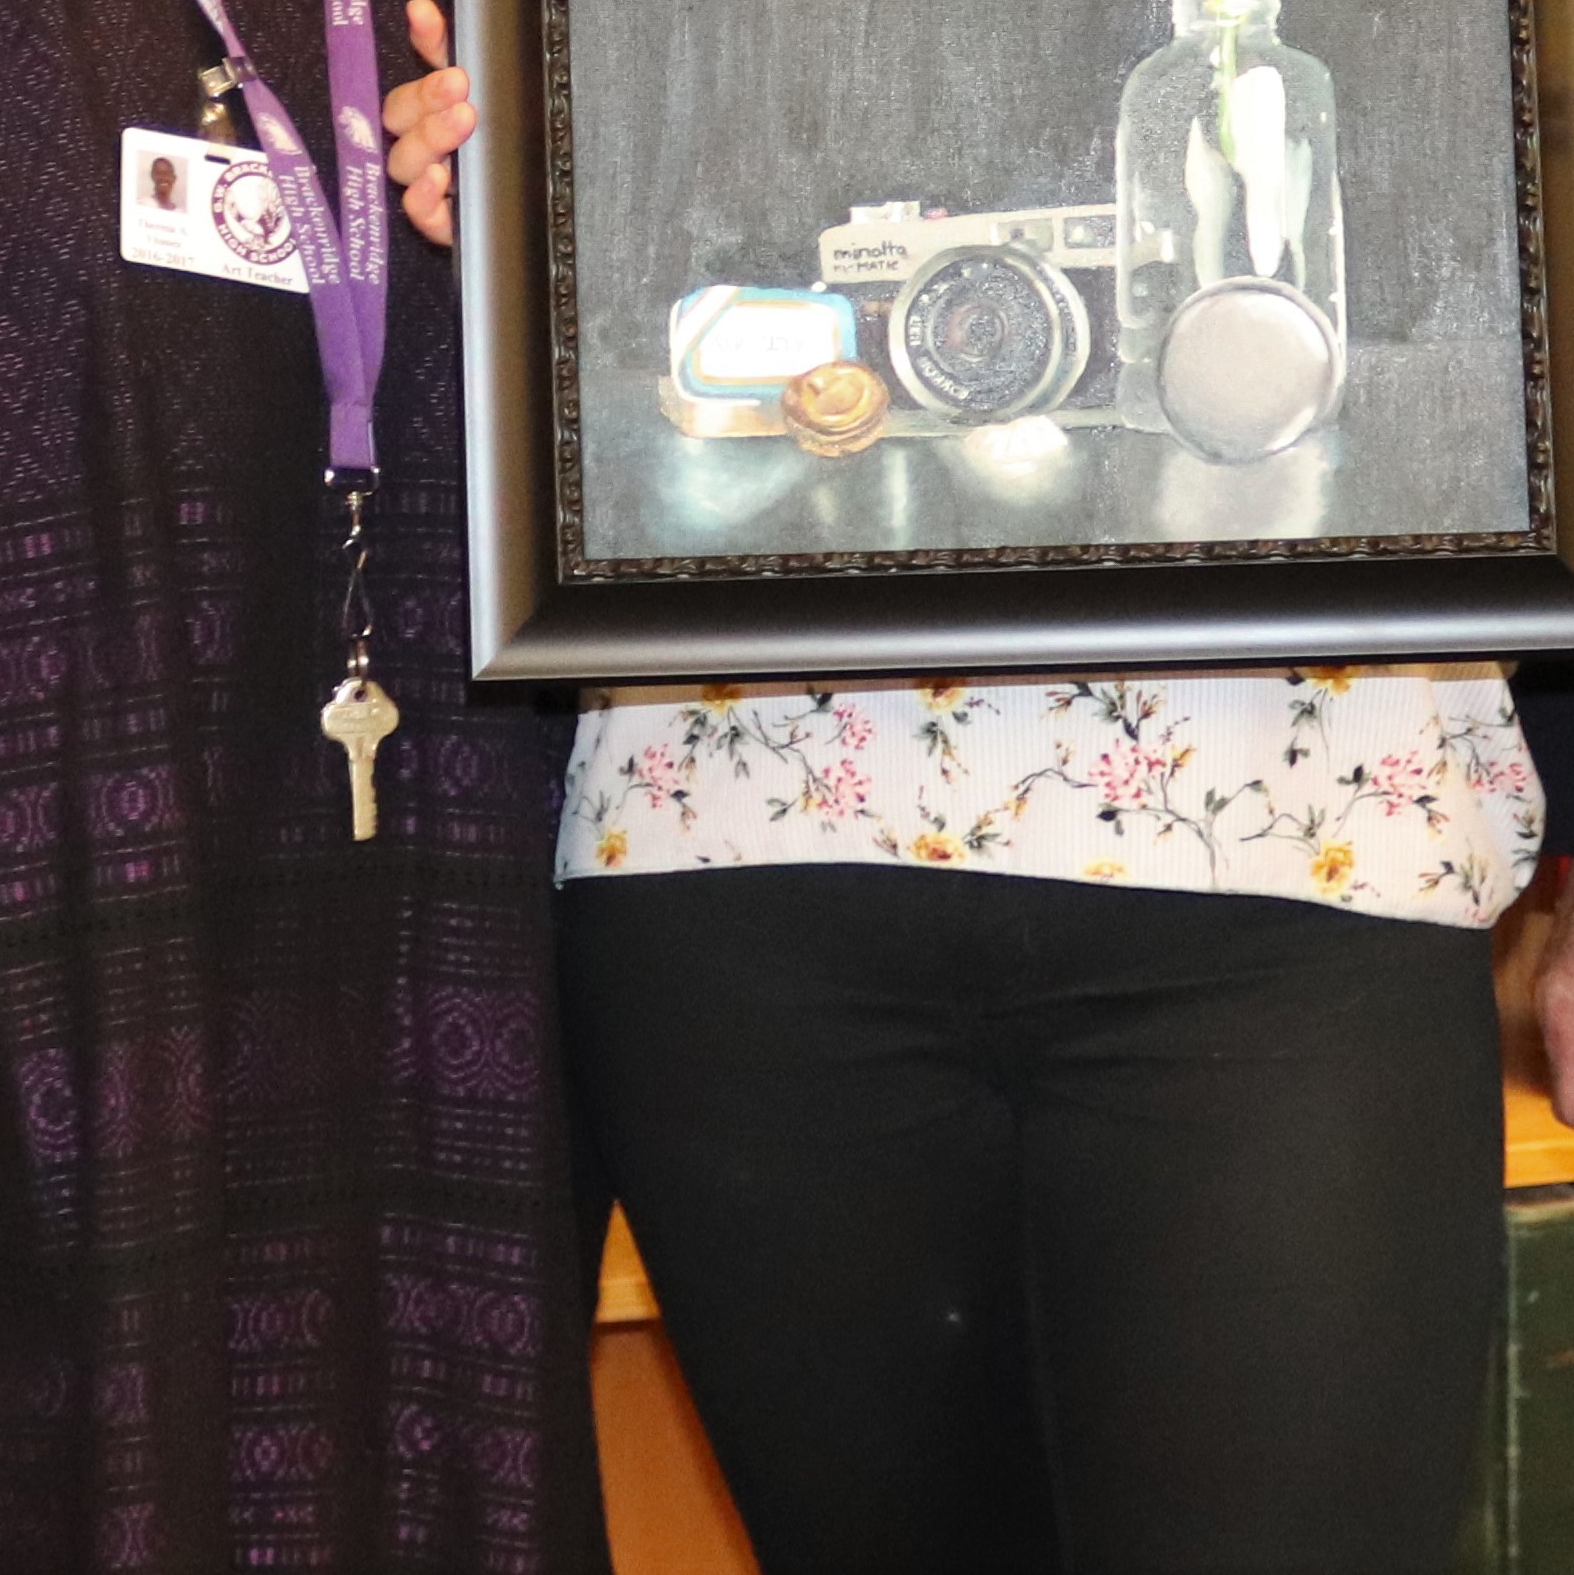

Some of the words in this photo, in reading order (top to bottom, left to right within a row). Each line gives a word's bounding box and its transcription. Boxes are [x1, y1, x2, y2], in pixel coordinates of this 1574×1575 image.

[833, 241, 908, 262] minolta
[223, 263, 241, 276] Art
[248, 267, 293, 285] Teacher
